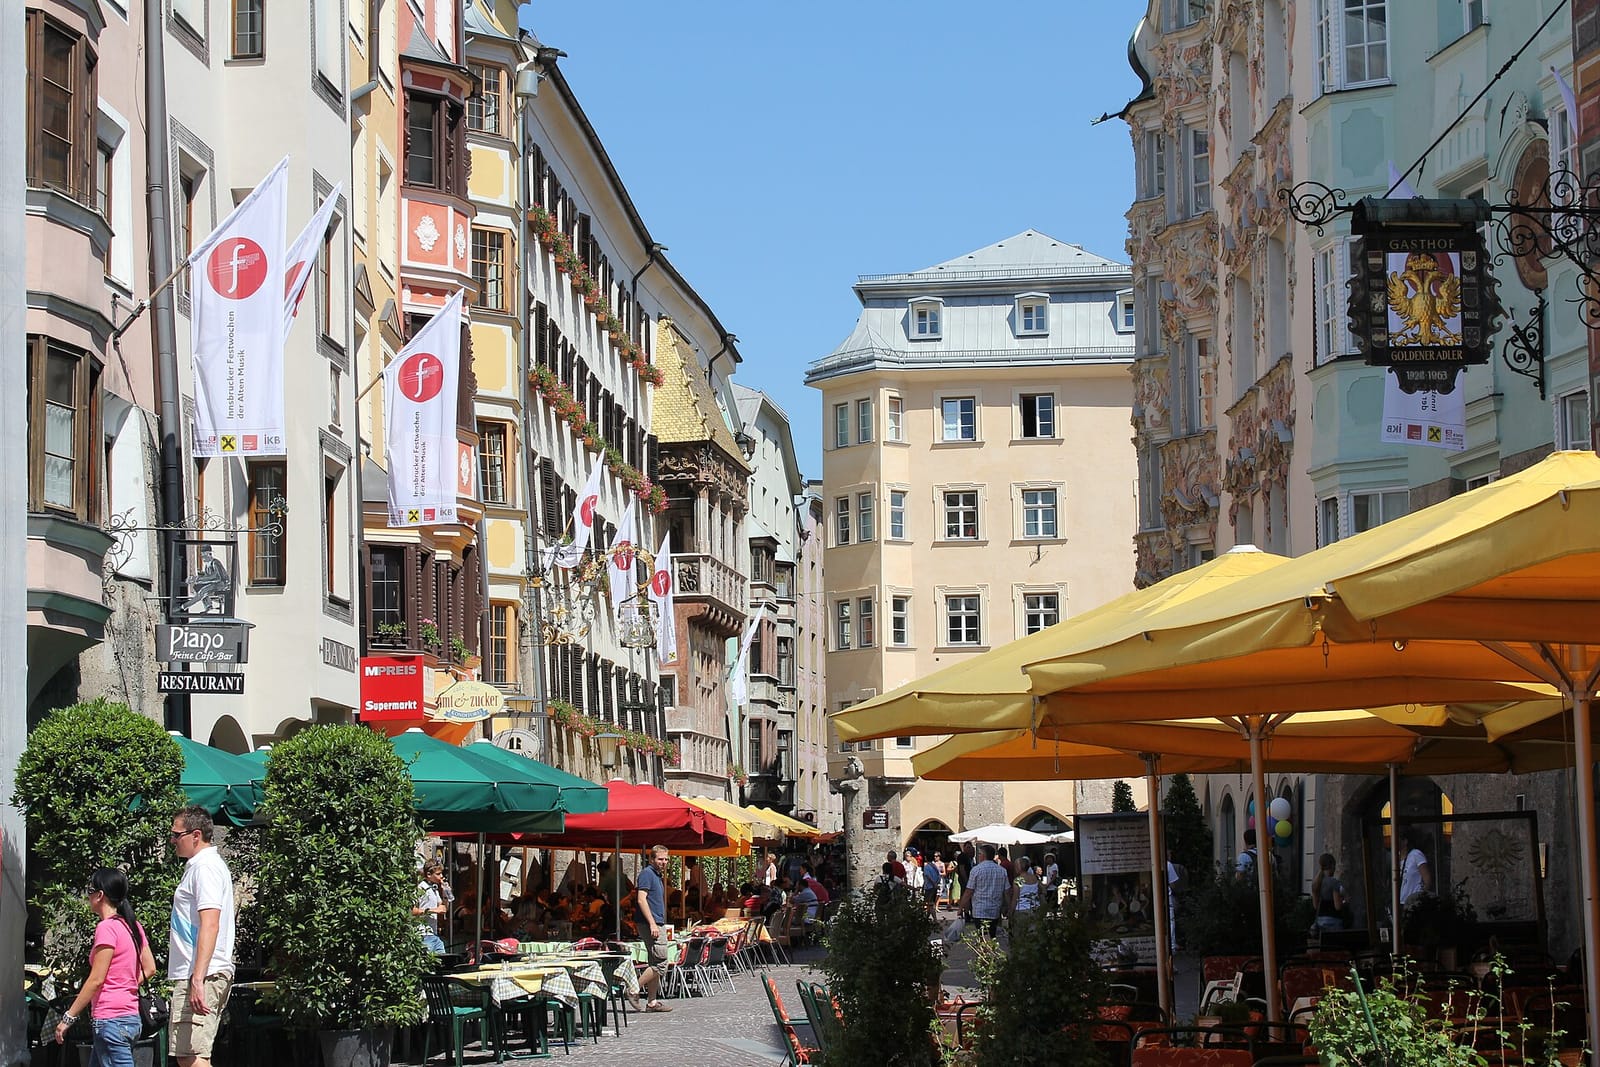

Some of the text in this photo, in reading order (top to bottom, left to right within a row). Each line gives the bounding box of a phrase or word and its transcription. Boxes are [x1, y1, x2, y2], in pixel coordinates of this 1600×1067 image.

[1389, 239, 1456, 250] GASTHOF
[1391, 349, 1463, 361] GOLDENER ADLER
[226, 310, 235, 420] Innsbrucker Festwochen
[236, 348, 245, 420] der Alten Musik
[413, 411, 421, 454] Festwochen
[169, 626, 225, 656] Piano
[172, 650, 194, 661] Feine
[324, 640, 355, 671] BANK
[365, 665, 417, 677] MPREIS
[160, 675, 243, 691] RESTAURANT
[365, 700, 417, 712] Supermarkt
[470, 691, 498, 707] zucker
